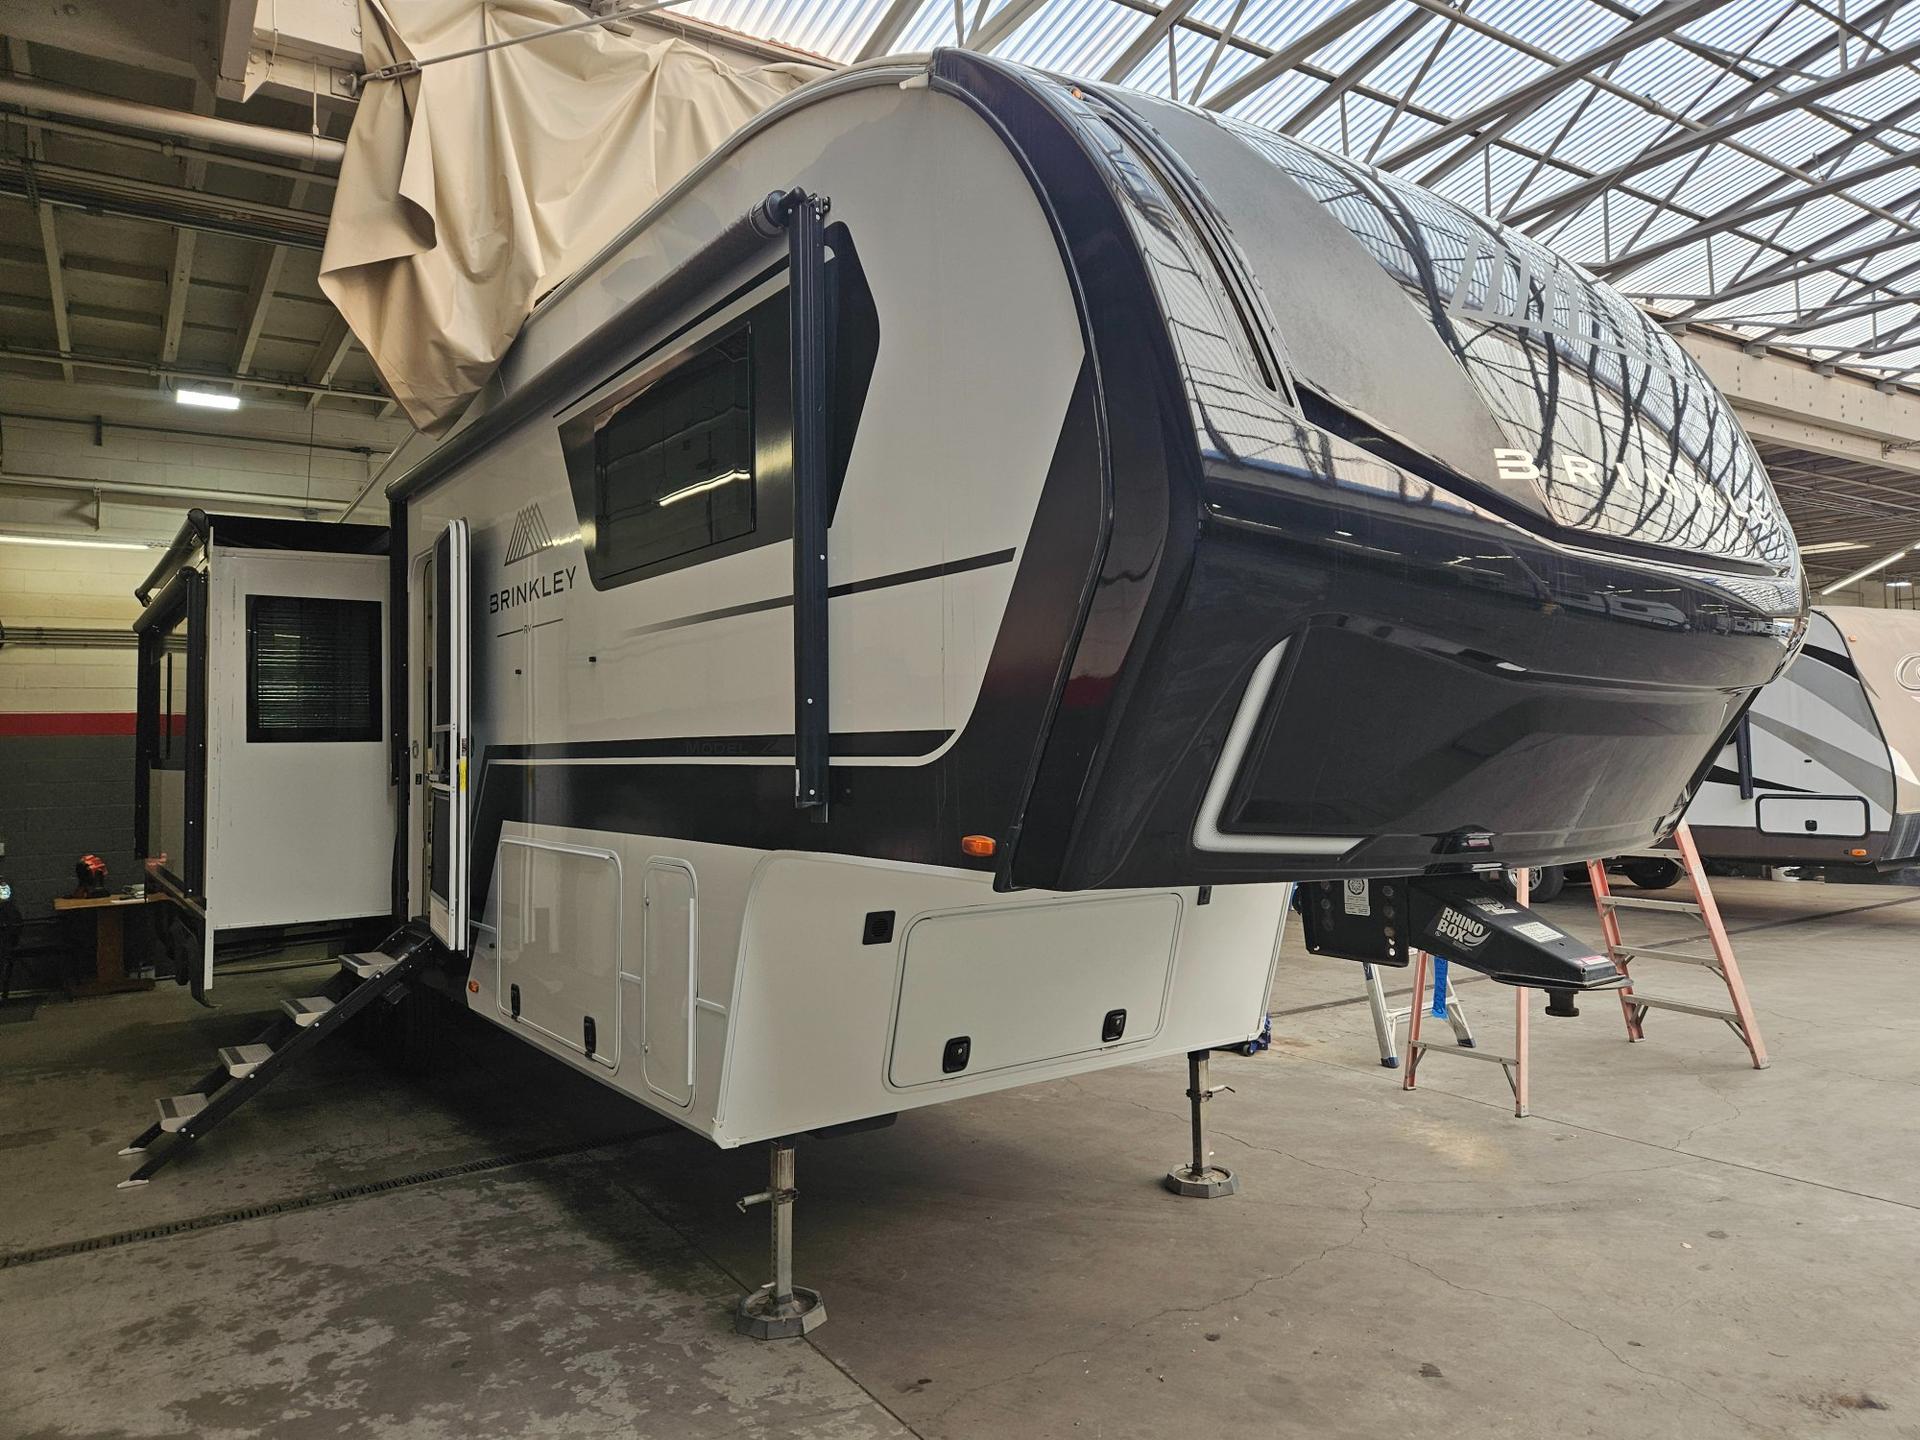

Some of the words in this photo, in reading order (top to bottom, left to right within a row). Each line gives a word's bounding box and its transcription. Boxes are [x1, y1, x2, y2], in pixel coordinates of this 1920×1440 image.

[489, 565, 577, 615] BRINKLEY
[523, 624, 533, 634] RV
[686, 742, 747, 754] MODEL
[1436, 918, 1468, 943] BOX
[1441, 906, 1485, 937] RHINO
